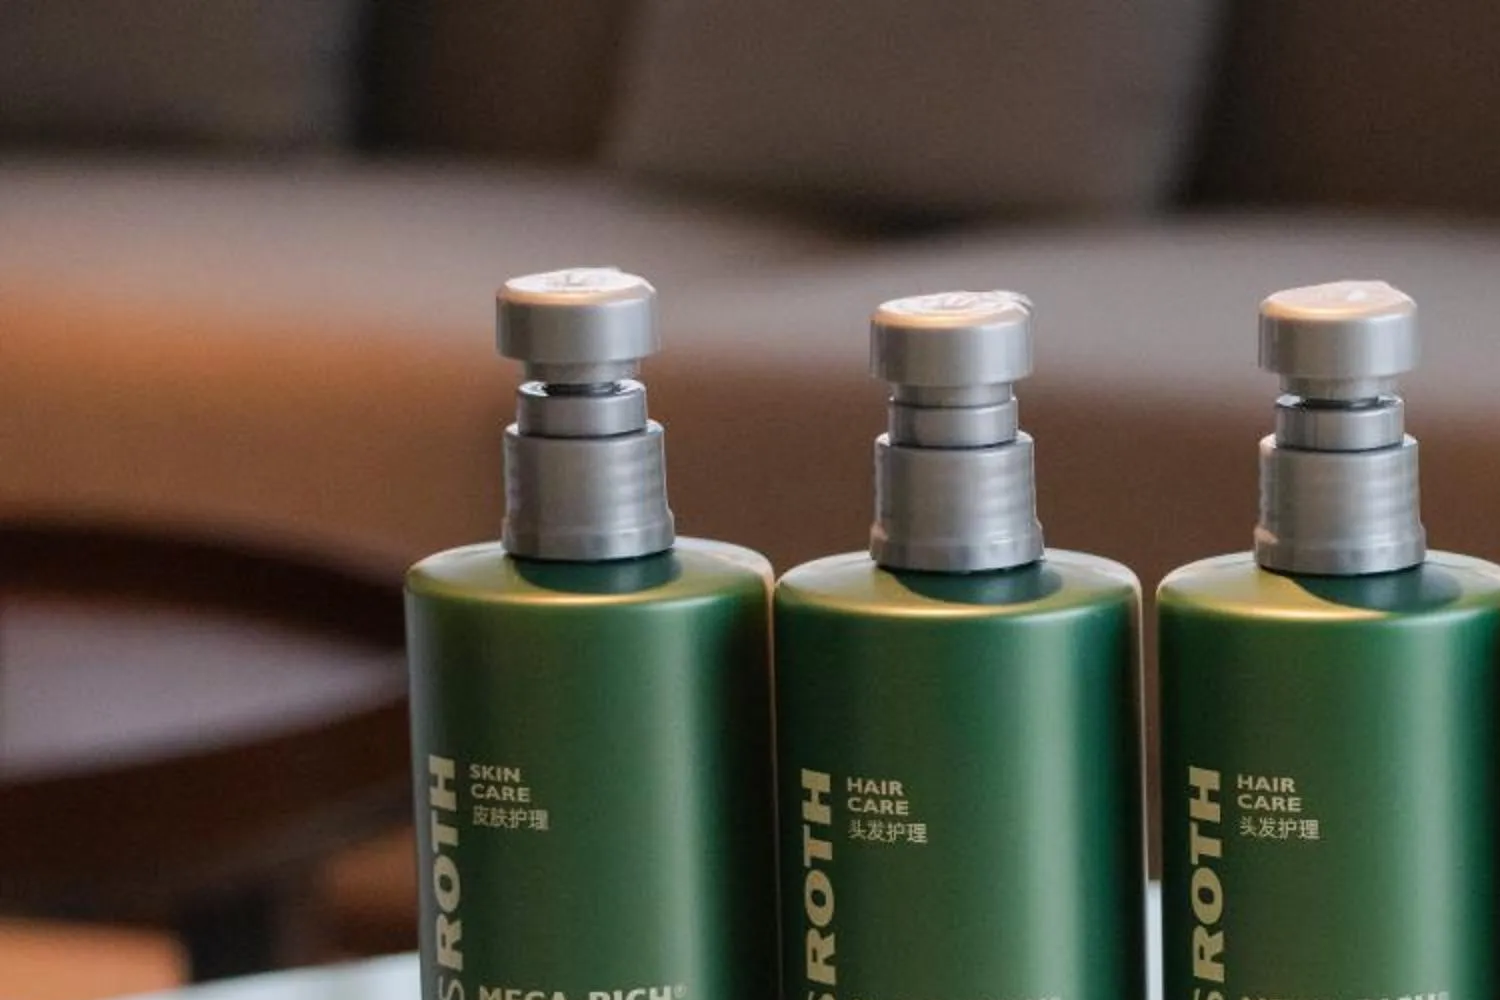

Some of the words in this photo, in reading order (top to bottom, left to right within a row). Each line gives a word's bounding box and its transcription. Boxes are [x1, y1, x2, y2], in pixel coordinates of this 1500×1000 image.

[469, 763, 521, 783] SKIN
[470, 783, 531, 803] CARE
[847, 777, 904, 797] HAIR
[1237, 774, 1296, 793] HAIR
[847, 796, 909, 817] CARE
[1237, 793, 1302, 813] CARE
[472, 804, 549, 831] 皮肤护理
[1239, 815, 1321, 840] 头发护理
[848, 819, 928, 844] 头发护理
